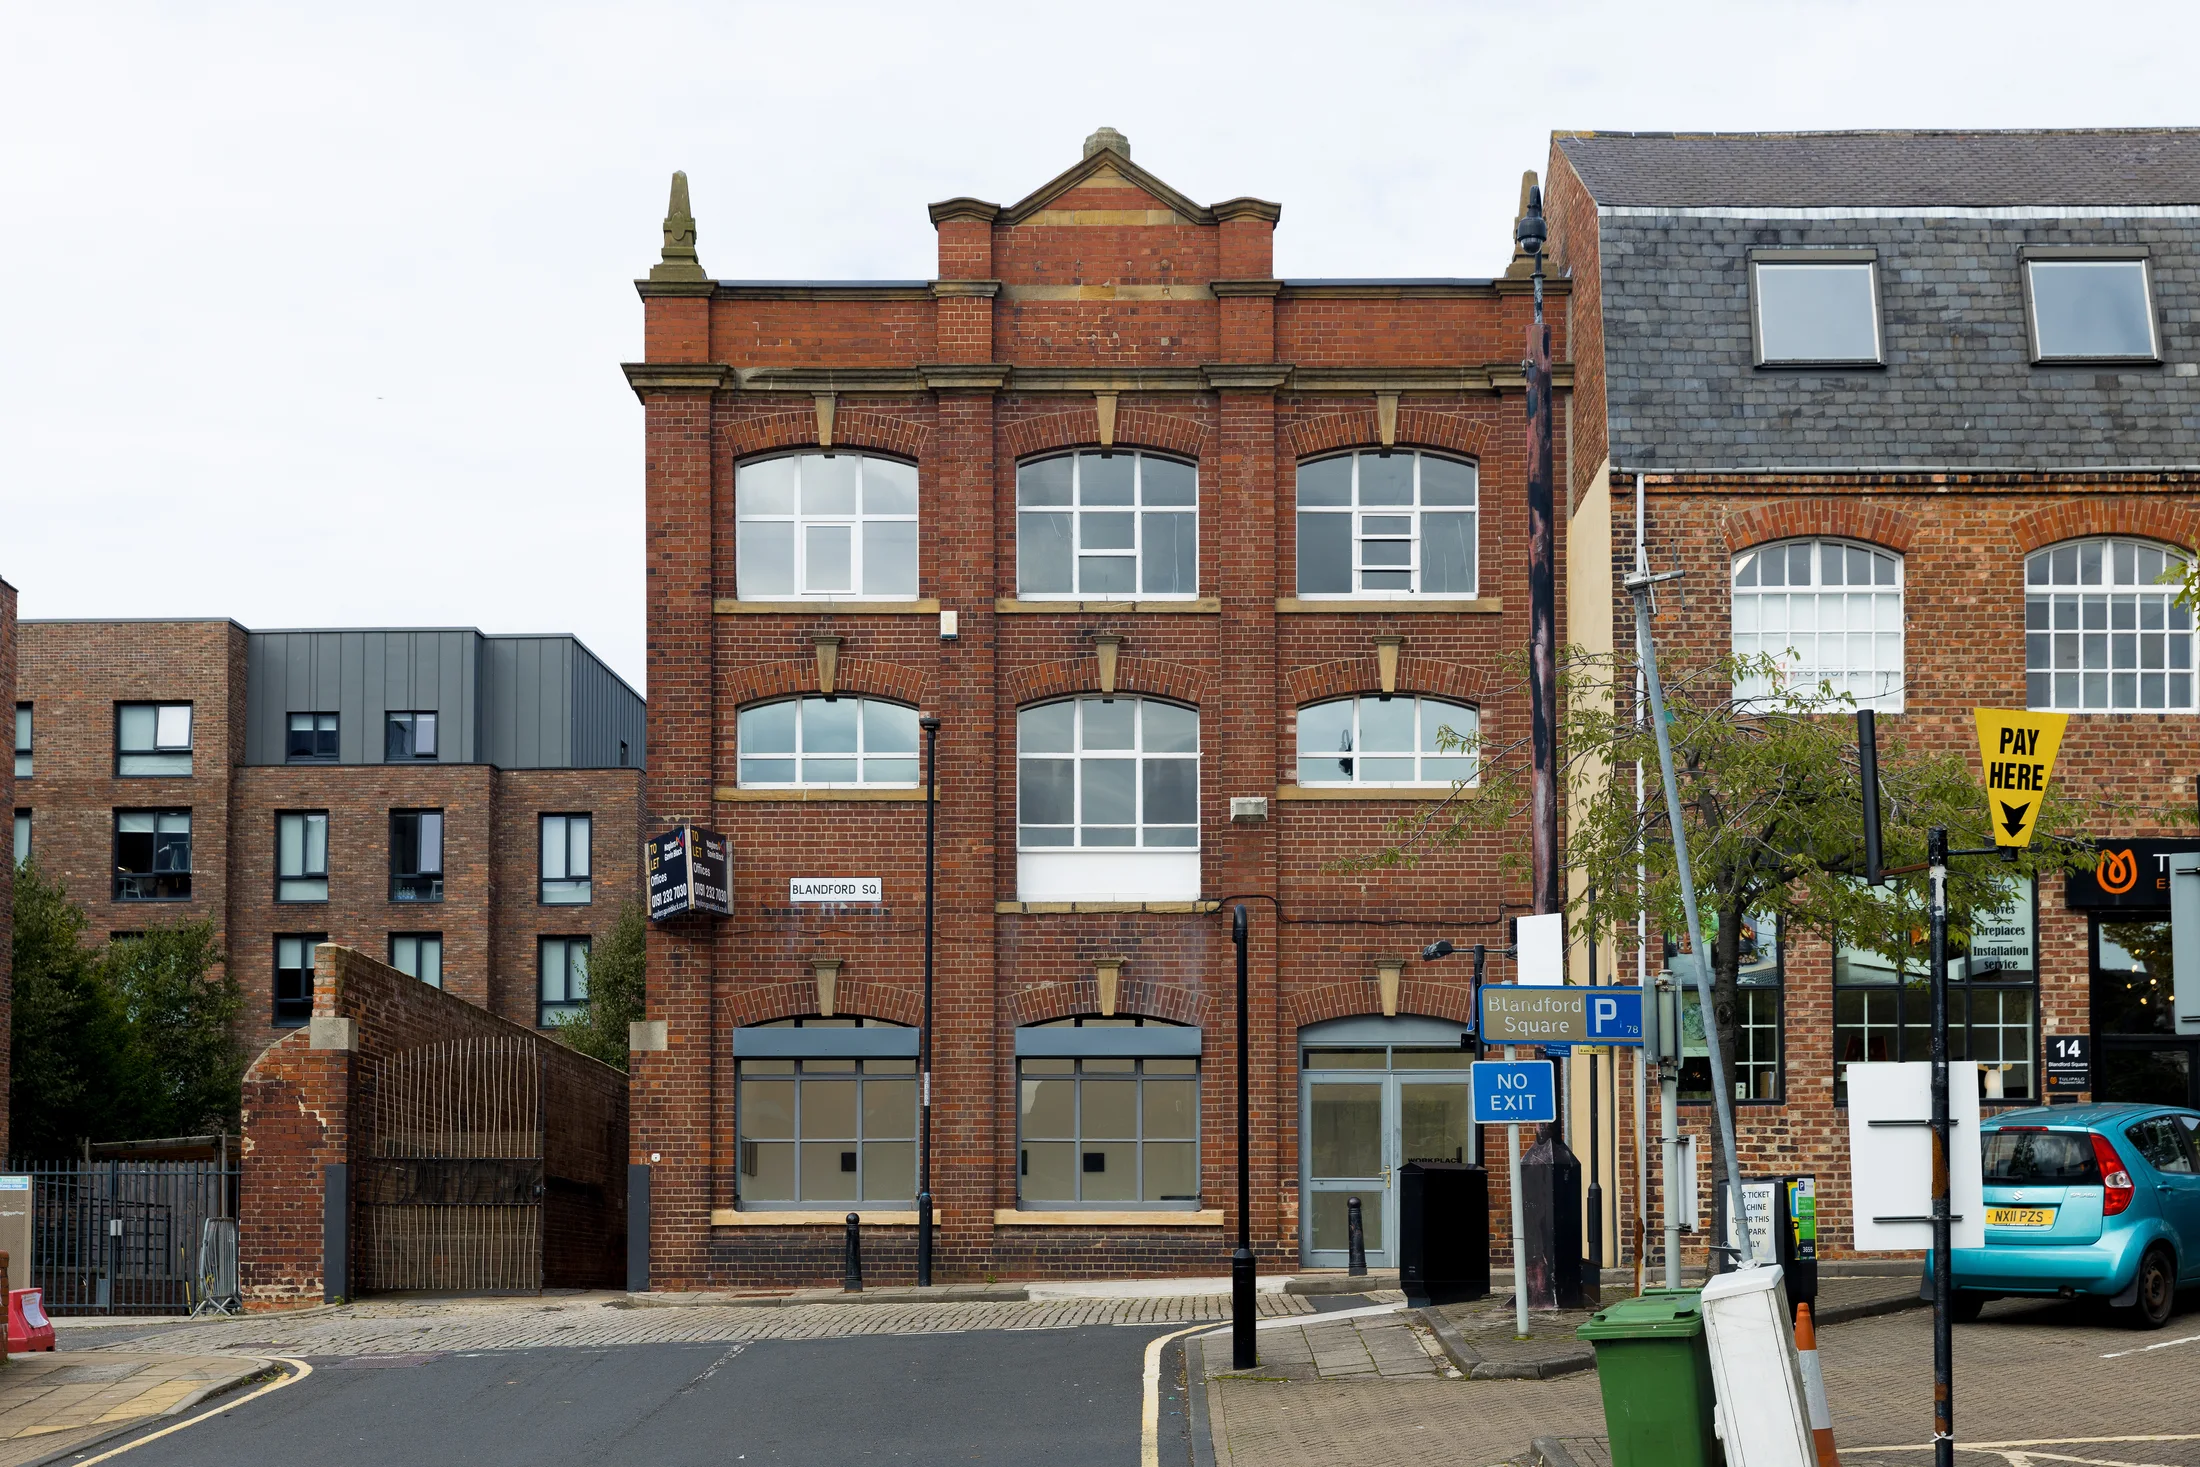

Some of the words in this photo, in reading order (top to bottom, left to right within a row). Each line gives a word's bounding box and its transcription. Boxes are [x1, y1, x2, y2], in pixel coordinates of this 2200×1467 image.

[2000, 727, 2040, 756] PAY
[1989, 761, 2044, 791] HERE
[691, 830, 699, 842] TO
[650, 843, 657, 855] TO
[664, 851, 674, 861] Gavin
[673, 847, 683, 857] Black
[692, 846, 702, 858] LET
[650, 857, 659, 870] LET
[693, 862, 711, 877] Offices
[651, 873, 667, 887] Offices
[663, 888, 673, 904] 232
[673, 883, 687, 900] 7030
[705, 885, 716, 899] 232
[716, 888, 727, 903] 7030
[792, 884, 856, 894] BLANDFORD
[862, 884, 880, 895] SQ.
[1973, 946, 2029, 956] Installation
[1984, 959, 2019, 970] service
[1488, 996, 1582, 1013] Blandford
[1504, 1016, 1570, 1036] Square
[1627, 1025, 1639, 1034] 78
[2056, 1040, 2081, 1058] 14
[1497, 1073, 1528, 1089] NO
[1490, 1094, 1536, 1111] EXIT
[1995, 1210, 2016, 1222] NX11
[2019, 1211, 2044, 1223] PZS
